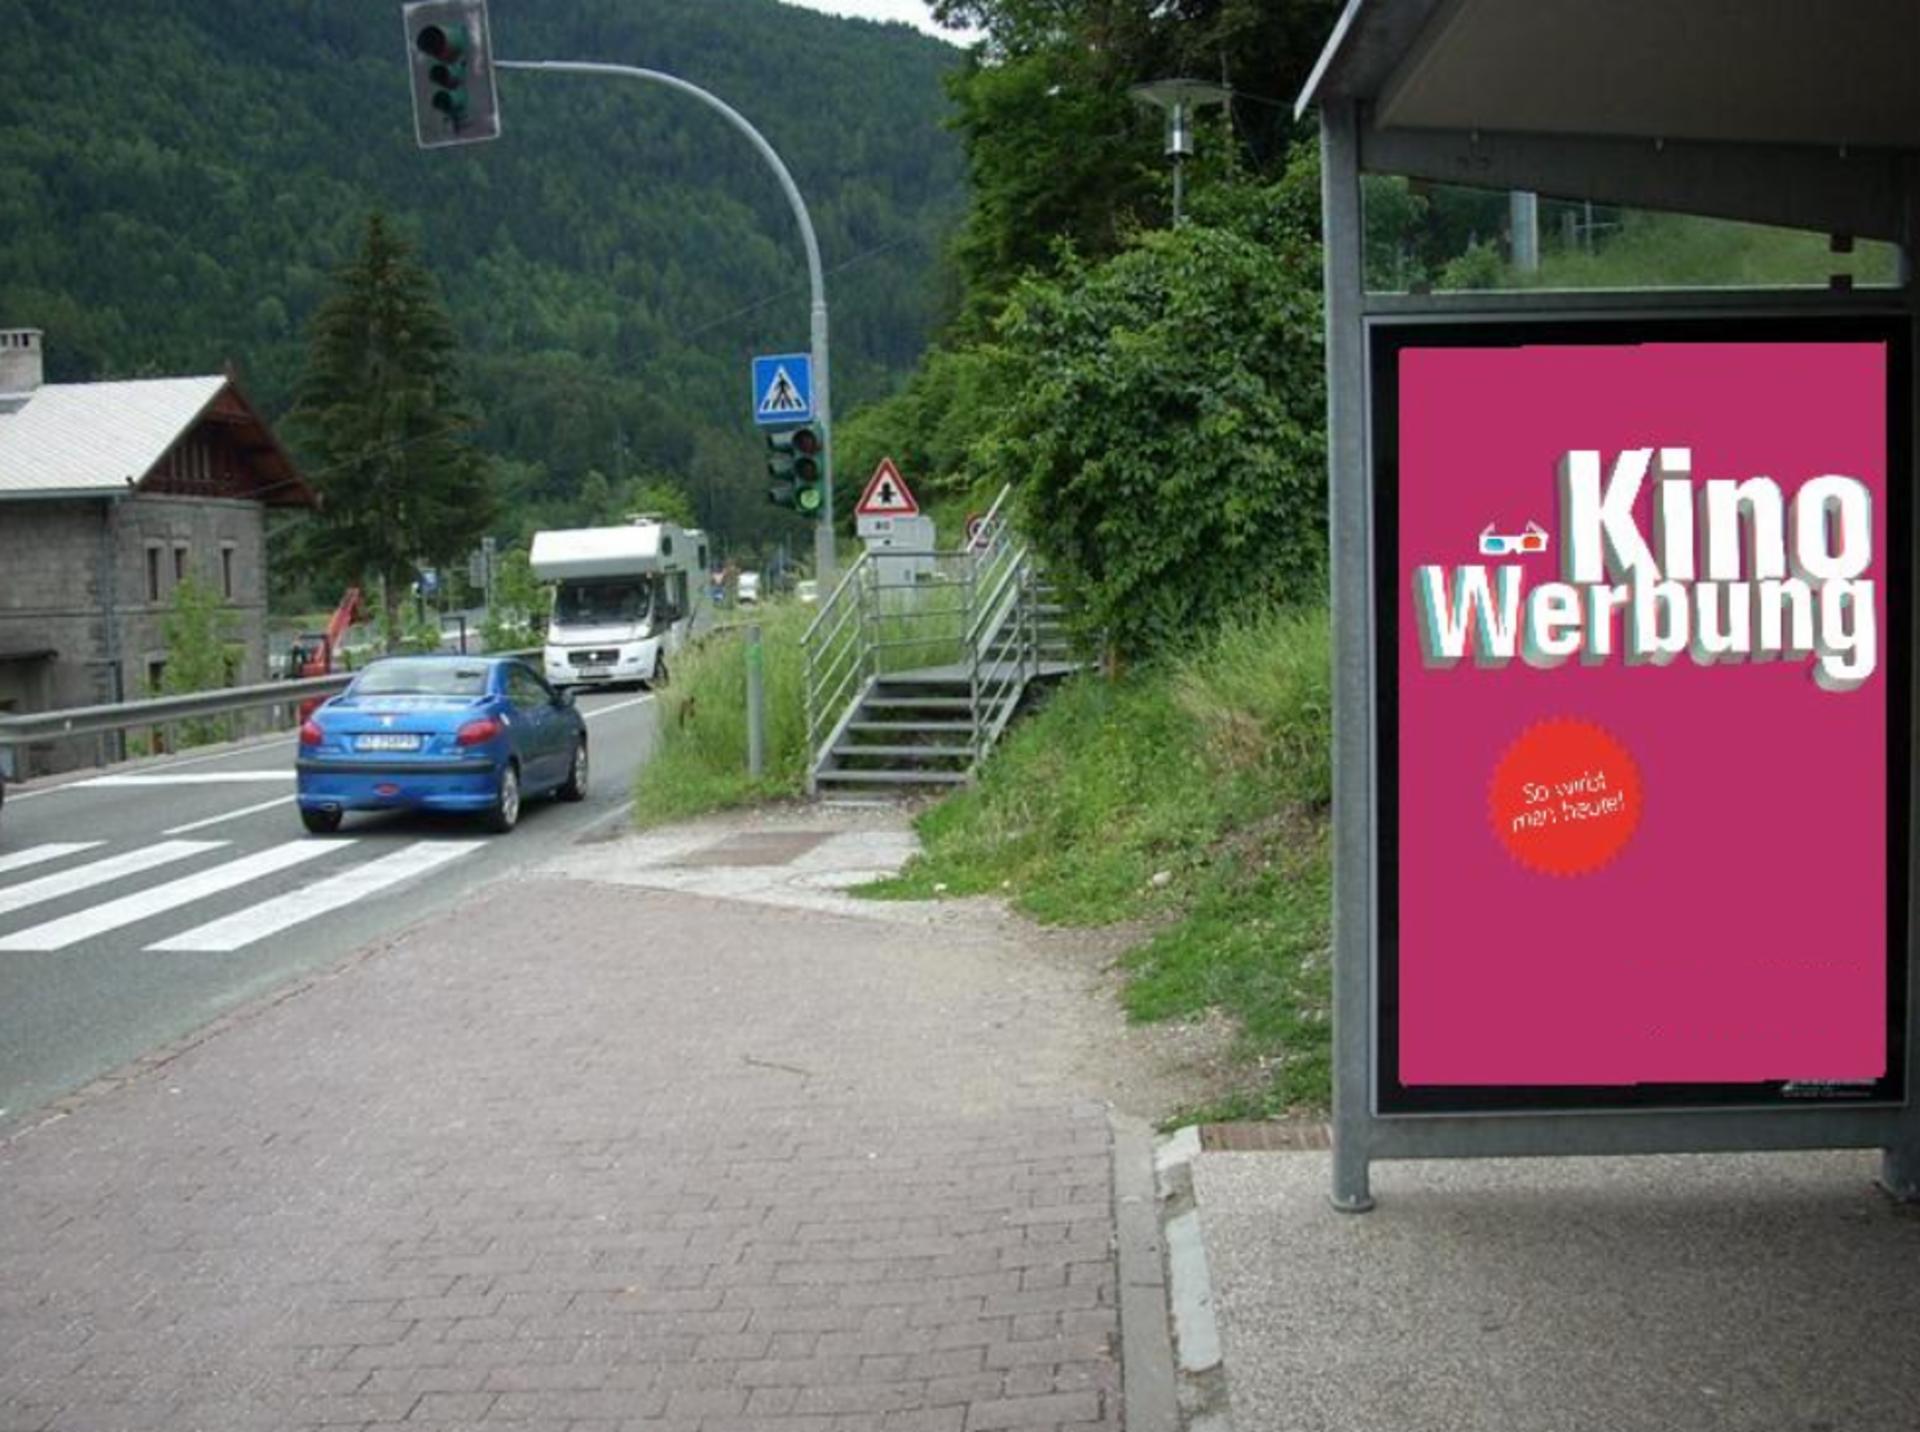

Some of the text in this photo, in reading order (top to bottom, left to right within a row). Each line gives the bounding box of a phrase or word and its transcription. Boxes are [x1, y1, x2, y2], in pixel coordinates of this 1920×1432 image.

[1564, 447, 1873, 582] Kino
[1418, 563, 1877, 690] Werbung
[1511, 789, 1625, 833] man heute!
[1522, 782, 1549, 804] So
